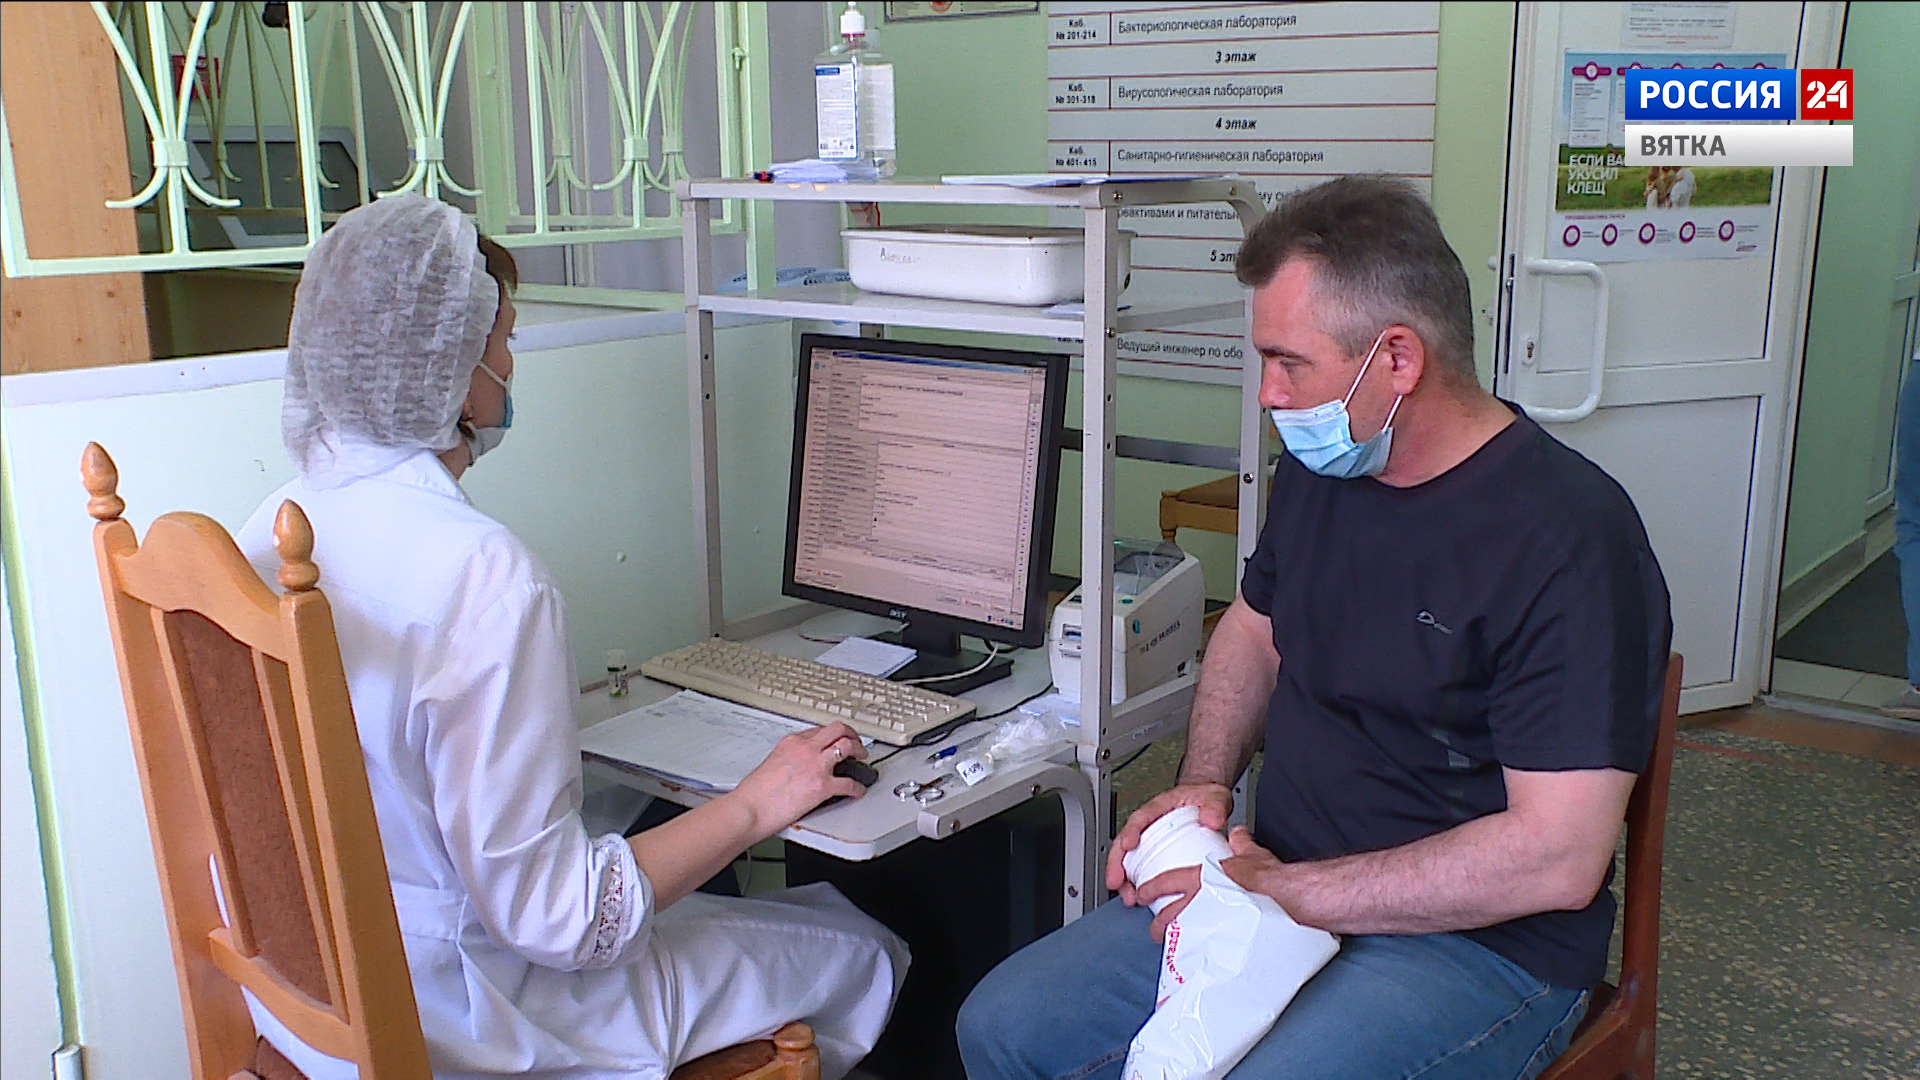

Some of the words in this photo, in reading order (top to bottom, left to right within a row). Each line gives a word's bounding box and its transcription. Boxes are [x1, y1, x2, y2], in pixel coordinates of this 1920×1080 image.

[1118, 19, 1223, 35] Бактериологическая
[1225, 15, 1297, 30] лаборатория
[1067, 30, 1096, 40] 201-214
[1215, 51, 1222, 63] 3
[1225, 51, 1257, 63] этаж
[1118, 85, 1211, 101] Вирусологическая
[1213, 83, 1283, 98] лаборатория
[1066, 94, 1096, 104] 301-318
[1215, 117, 1222, 129] 4
[1225, 118, 1257, 130] этаж
[1117, 149, 1249, 163] Санитарно-гигиеническая
[1251, 149, 1324, 164] лаборатория
[1569, 154, 1604, 167] ЕСЛИ
[1606, 153, 1626, 167] ВА
[1568, 167, 1619, 180] УКУСИЛ
[1567, 181, 1606, 196] КЛЕЩ
[1177, 208, 1184, 218] и
[1210, 249, 1217, 262] 5
[1117, 338, 1161, 353] Ведущий
[1162, 343, 1206, 357] инженер
[1208, 347, 1221, 357] по
